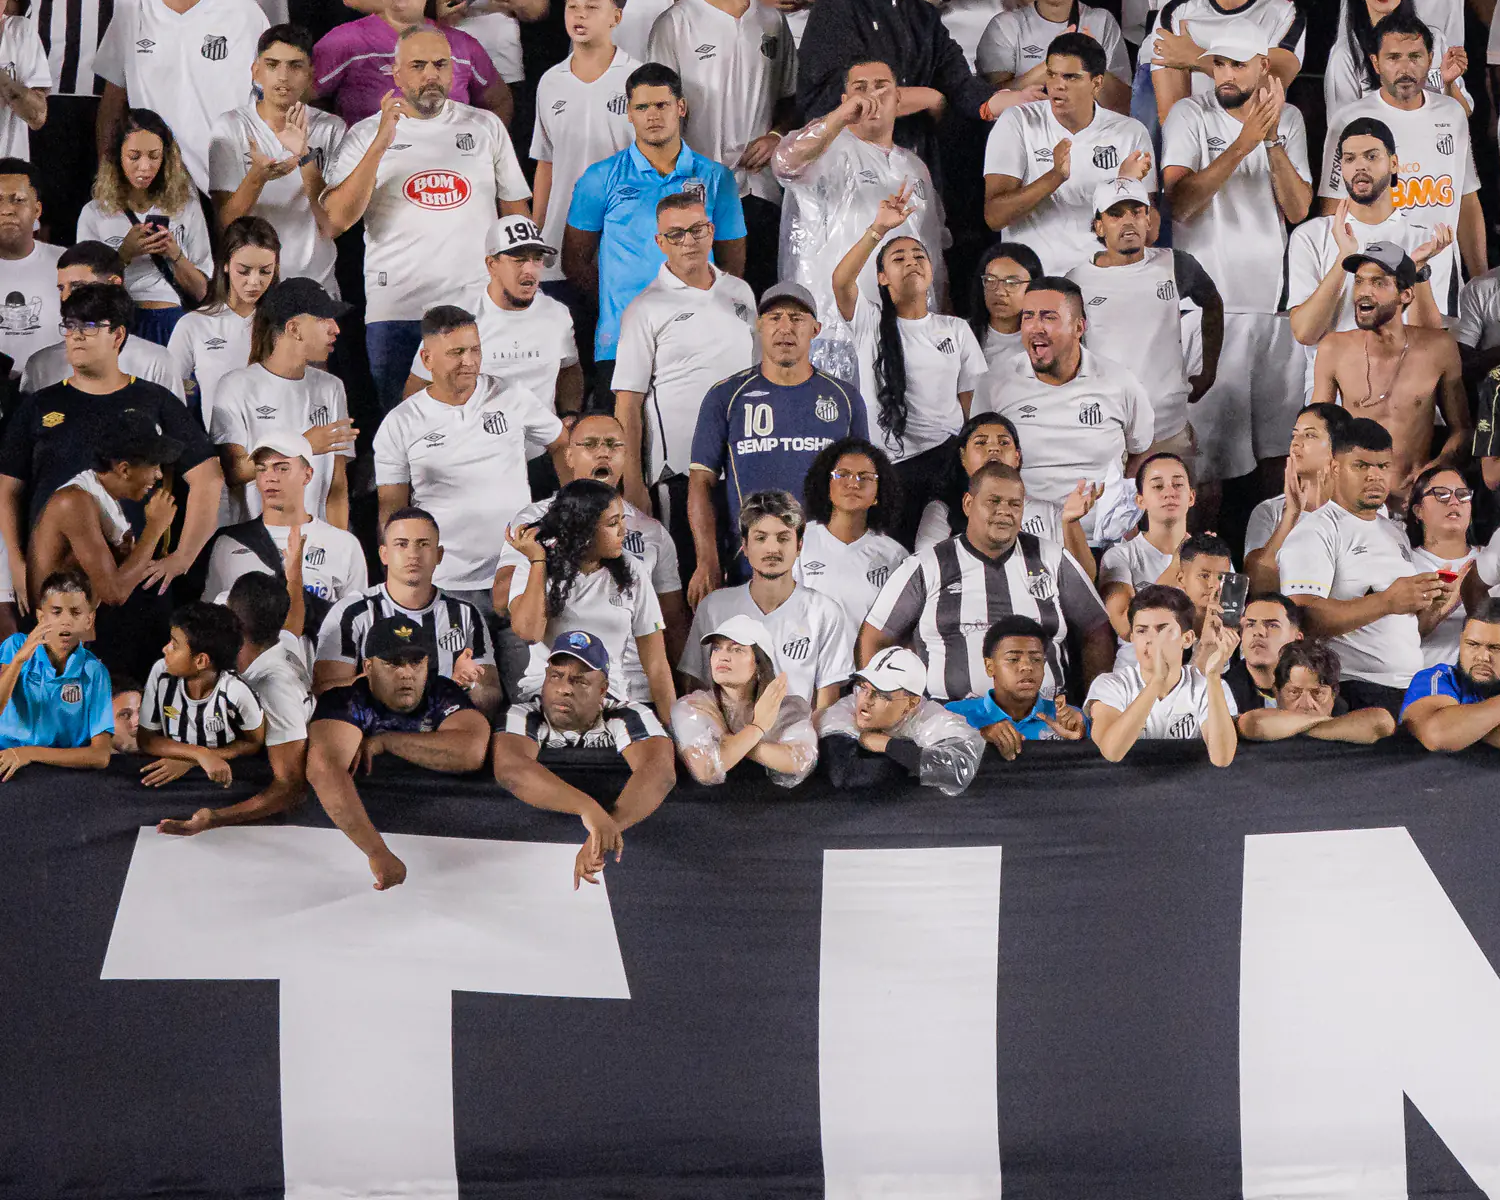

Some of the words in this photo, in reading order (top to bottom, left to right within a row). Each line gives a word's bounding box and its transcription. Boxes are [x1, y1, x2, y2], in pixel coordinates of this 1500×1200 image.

[414, 175, 455, 193] BOM
[1391, 175, 1454, 210] BMG
[420, 187, 463, 207] BRIL
[744, 403, 775, 438] 10
[737, 437, 778, 455] SEMP
